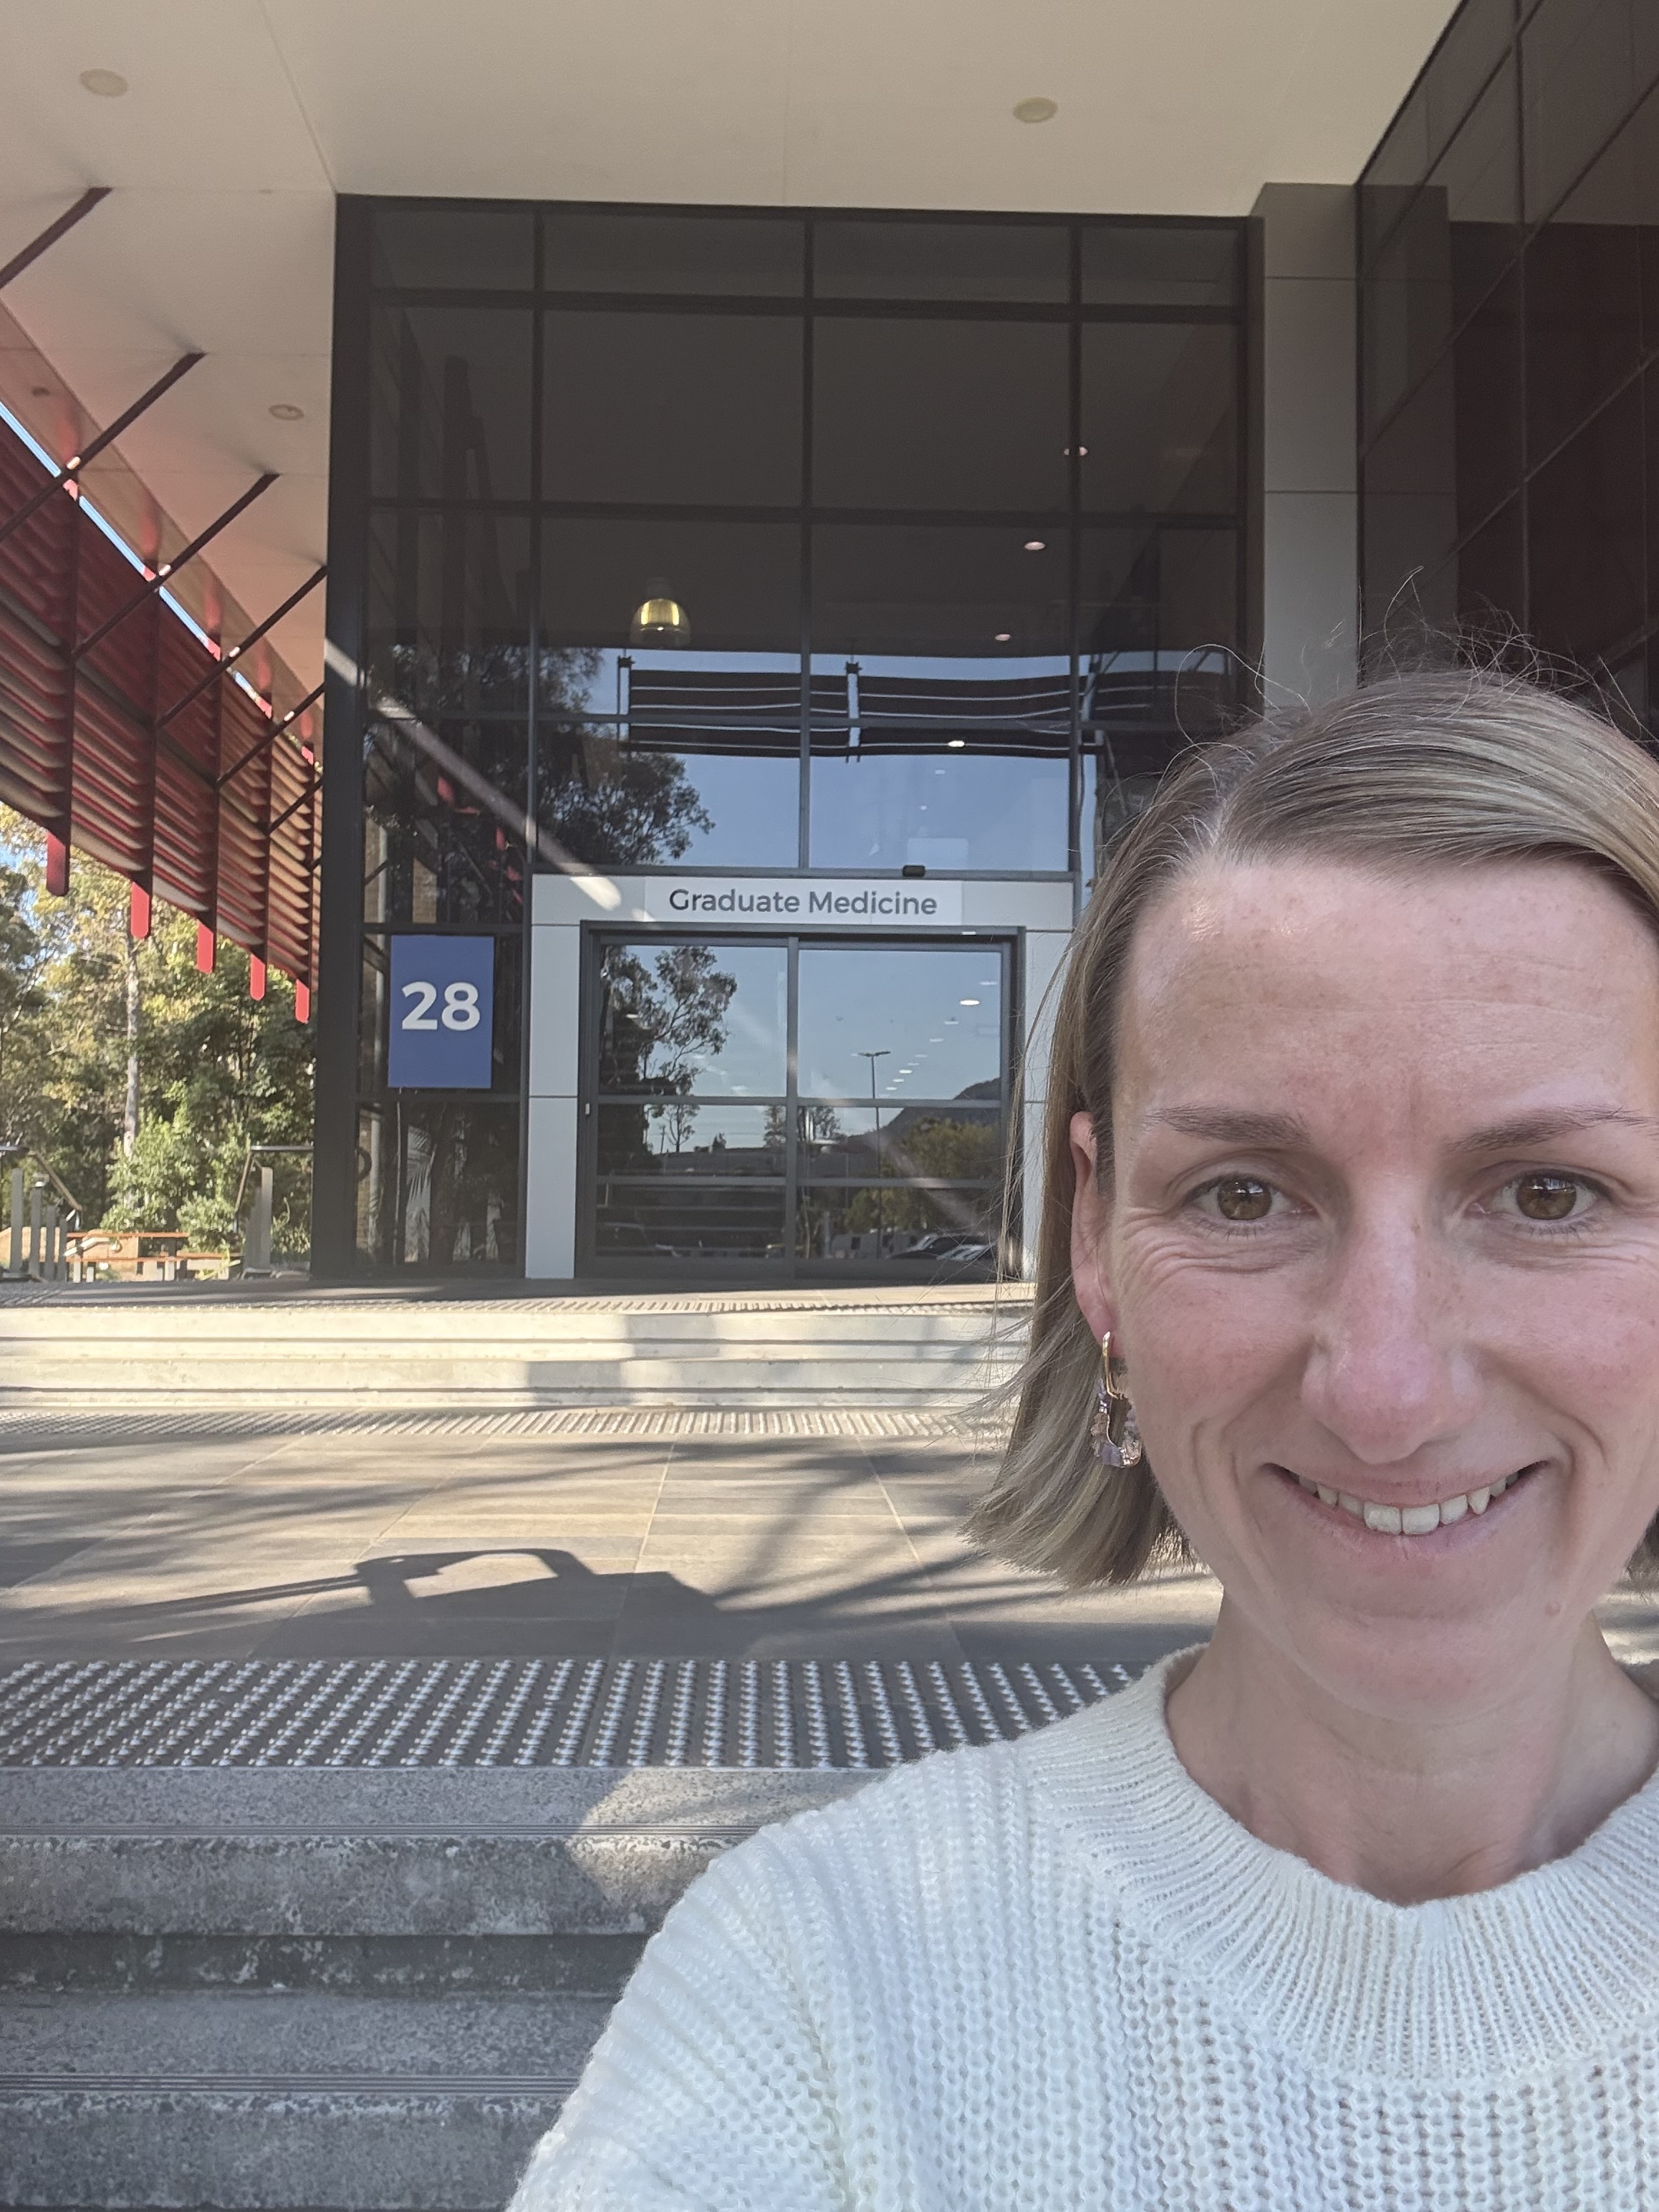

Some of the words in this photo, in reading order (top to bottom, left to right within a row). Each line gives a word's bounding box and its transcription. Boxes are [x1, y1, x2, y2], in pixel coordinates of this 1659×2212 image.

[669, 888, 800, 913] Graduate
[809, 890, 937, 915] Medicine
[402, 981, 481, 1031] 28
